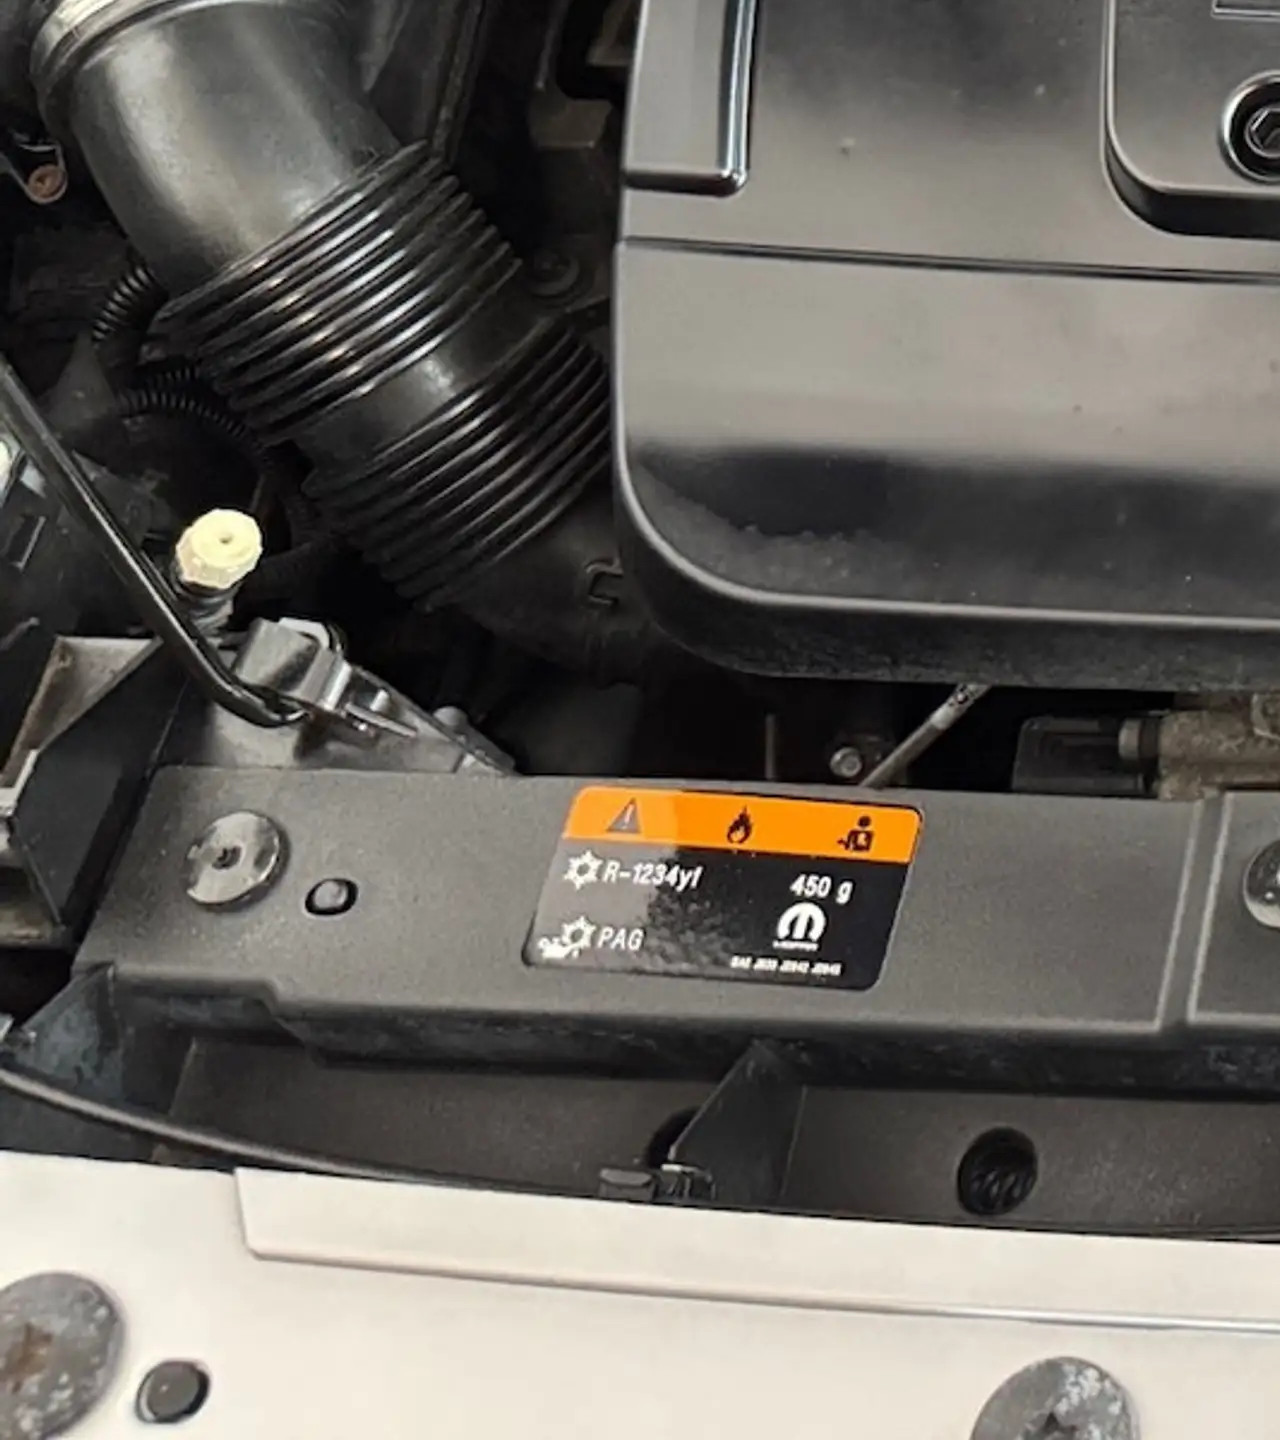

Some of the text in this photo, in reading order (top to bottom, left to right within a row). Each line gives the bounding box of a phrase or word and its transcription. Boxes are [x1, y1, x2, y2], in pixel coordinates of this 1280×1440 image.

[602, 859, 854, 906] R-1234yf 450 g
[597, 926, 645, 952] PAG
